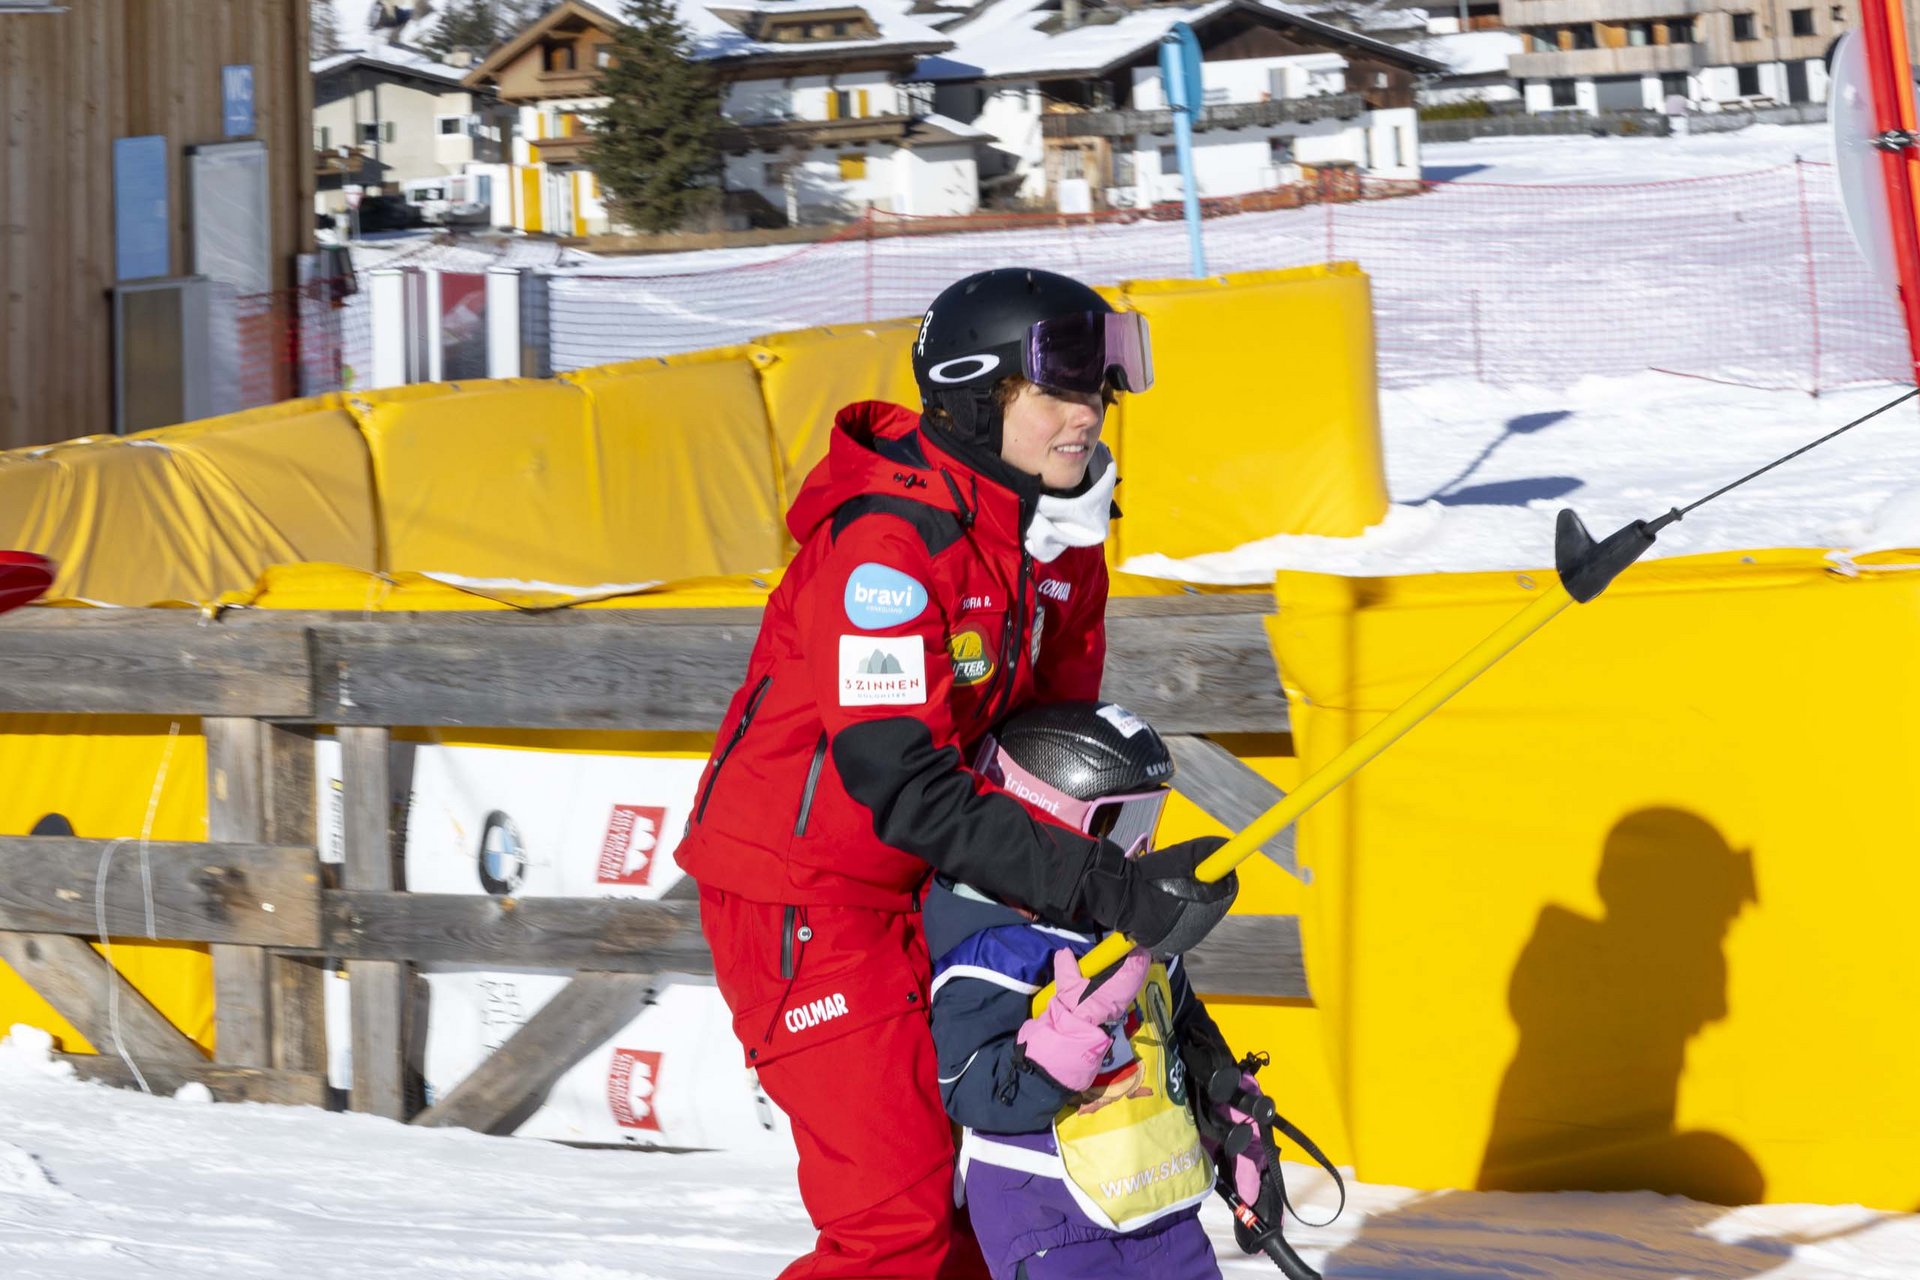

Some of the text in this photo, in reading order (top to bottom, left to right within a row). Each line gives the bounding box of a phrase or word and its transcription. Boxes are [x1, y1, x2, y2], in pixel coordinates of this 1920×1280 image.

[855, 582, 913, 607] bravi
[962, 596, 982, 610] SOFIA
[855, 678, 919, 691] ZINNEN
[785, 992, 849, 1034] COLMAR
